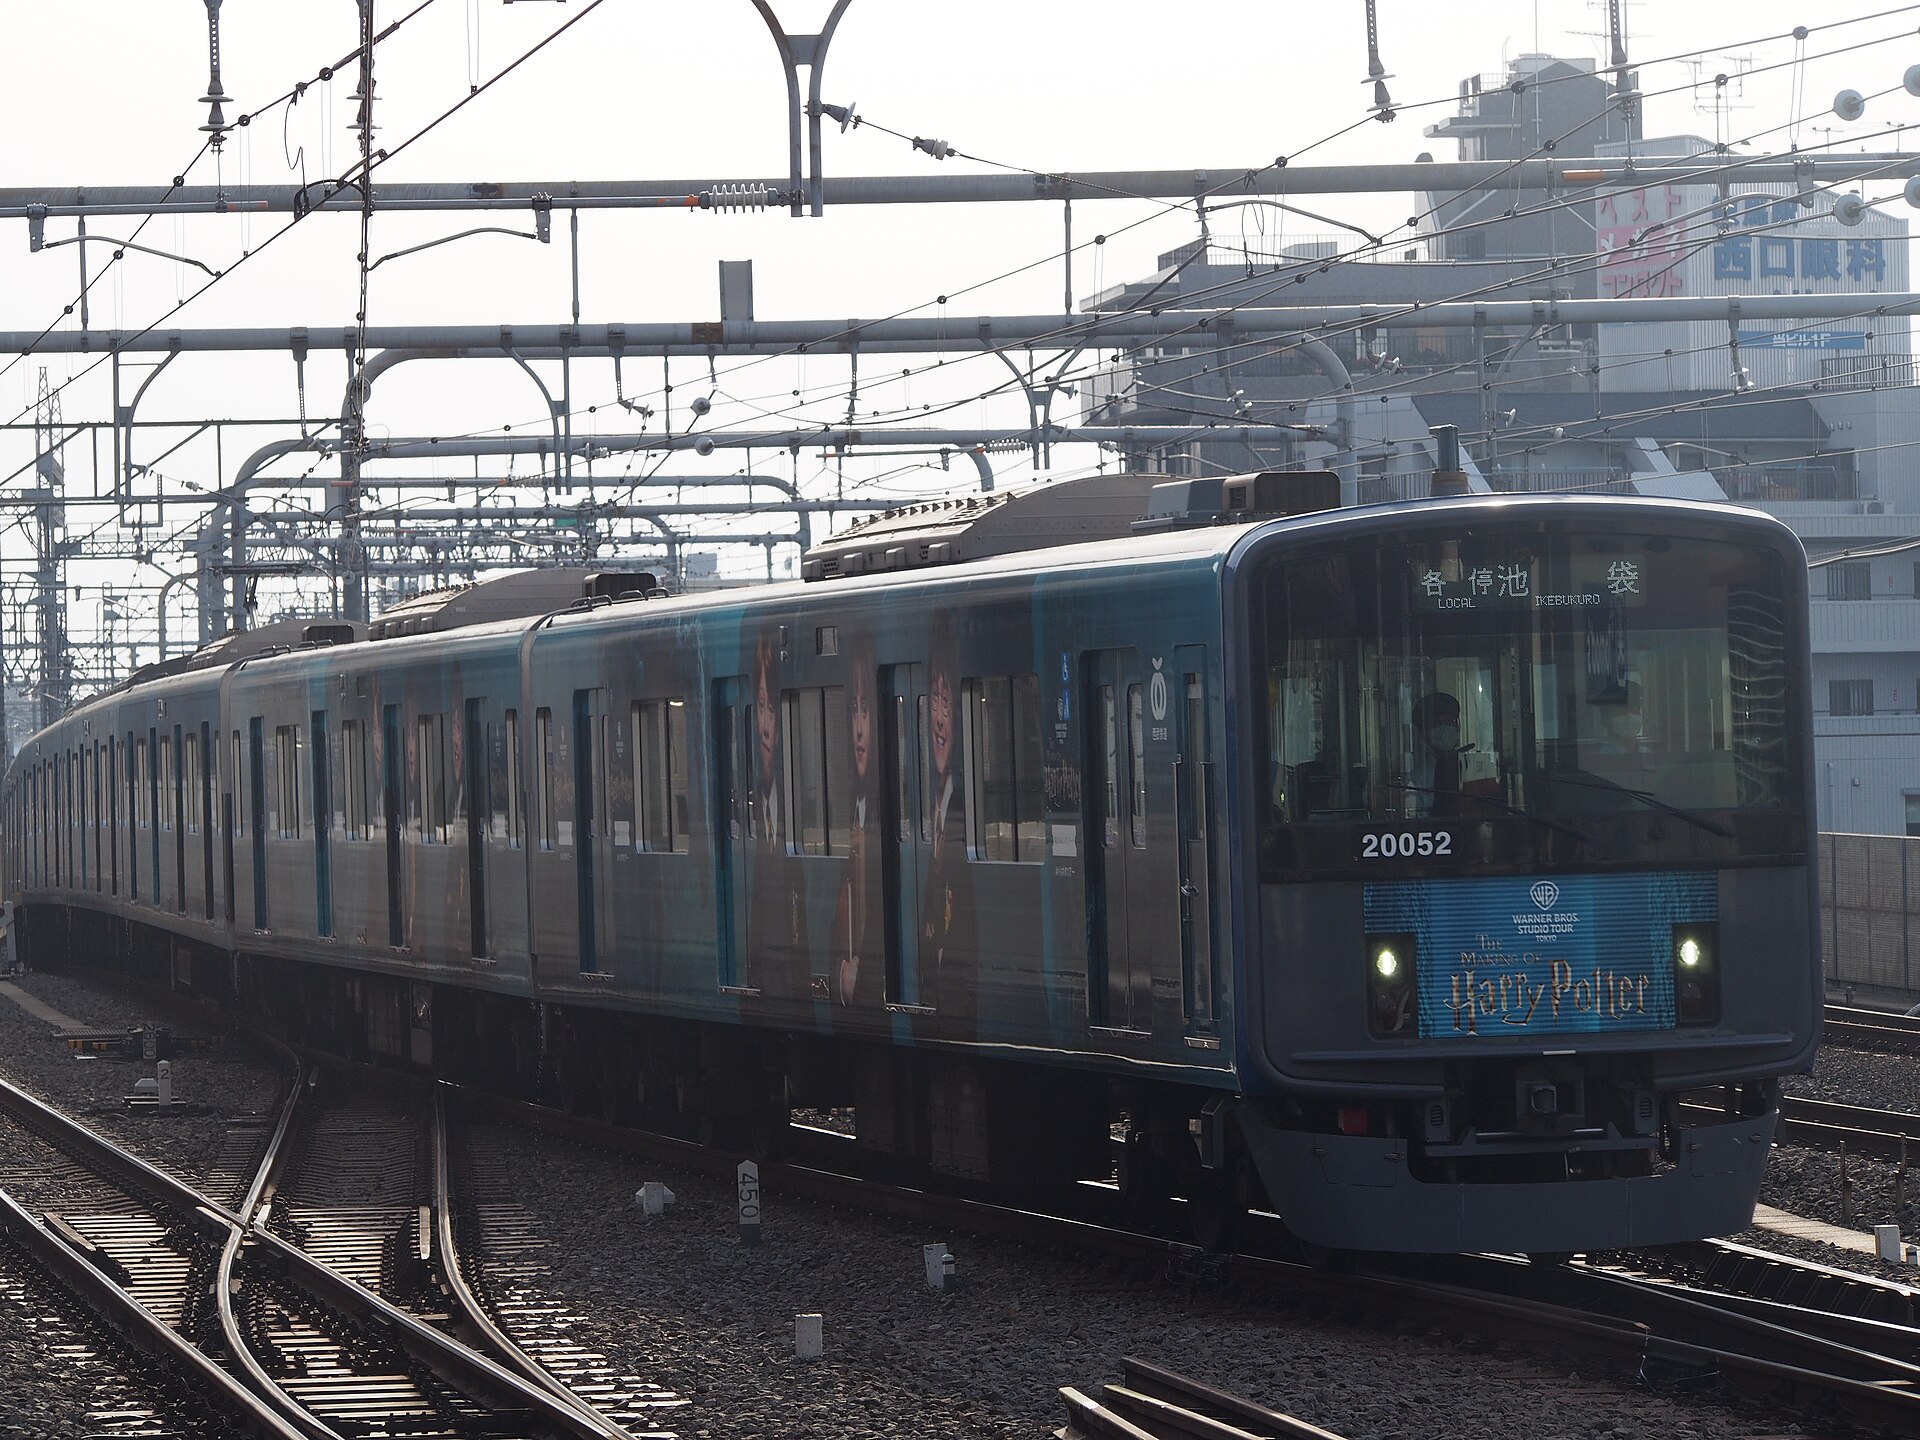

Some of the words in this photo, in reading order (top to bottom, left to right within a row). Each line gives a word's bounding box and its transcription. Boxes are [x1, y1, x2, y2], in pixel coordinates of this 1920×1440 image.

[1714, 234, 1886, 281] 西口眼科
[1438, 597, 1476, 609] LOCAL
[1535, 594, 1601, 606] IKEBUKURO
[1362, 831, 1452, 858] 20052
[1512, 914, 1552, 924] WARNER
[1554, 913, 1580, 923] BROS.
[1518, 924, 1549, 934] STUDIO
[1550, 923, 1574, 933] TOUR
[1443, 969, 1545, 1036] Harry
[1551, 959, 1650, 1023] Potter
[144, 1023, 156, 1058] 2600
[160, 1068, 170, 1080] 2
[739, 1172, 759, 1219] 450
